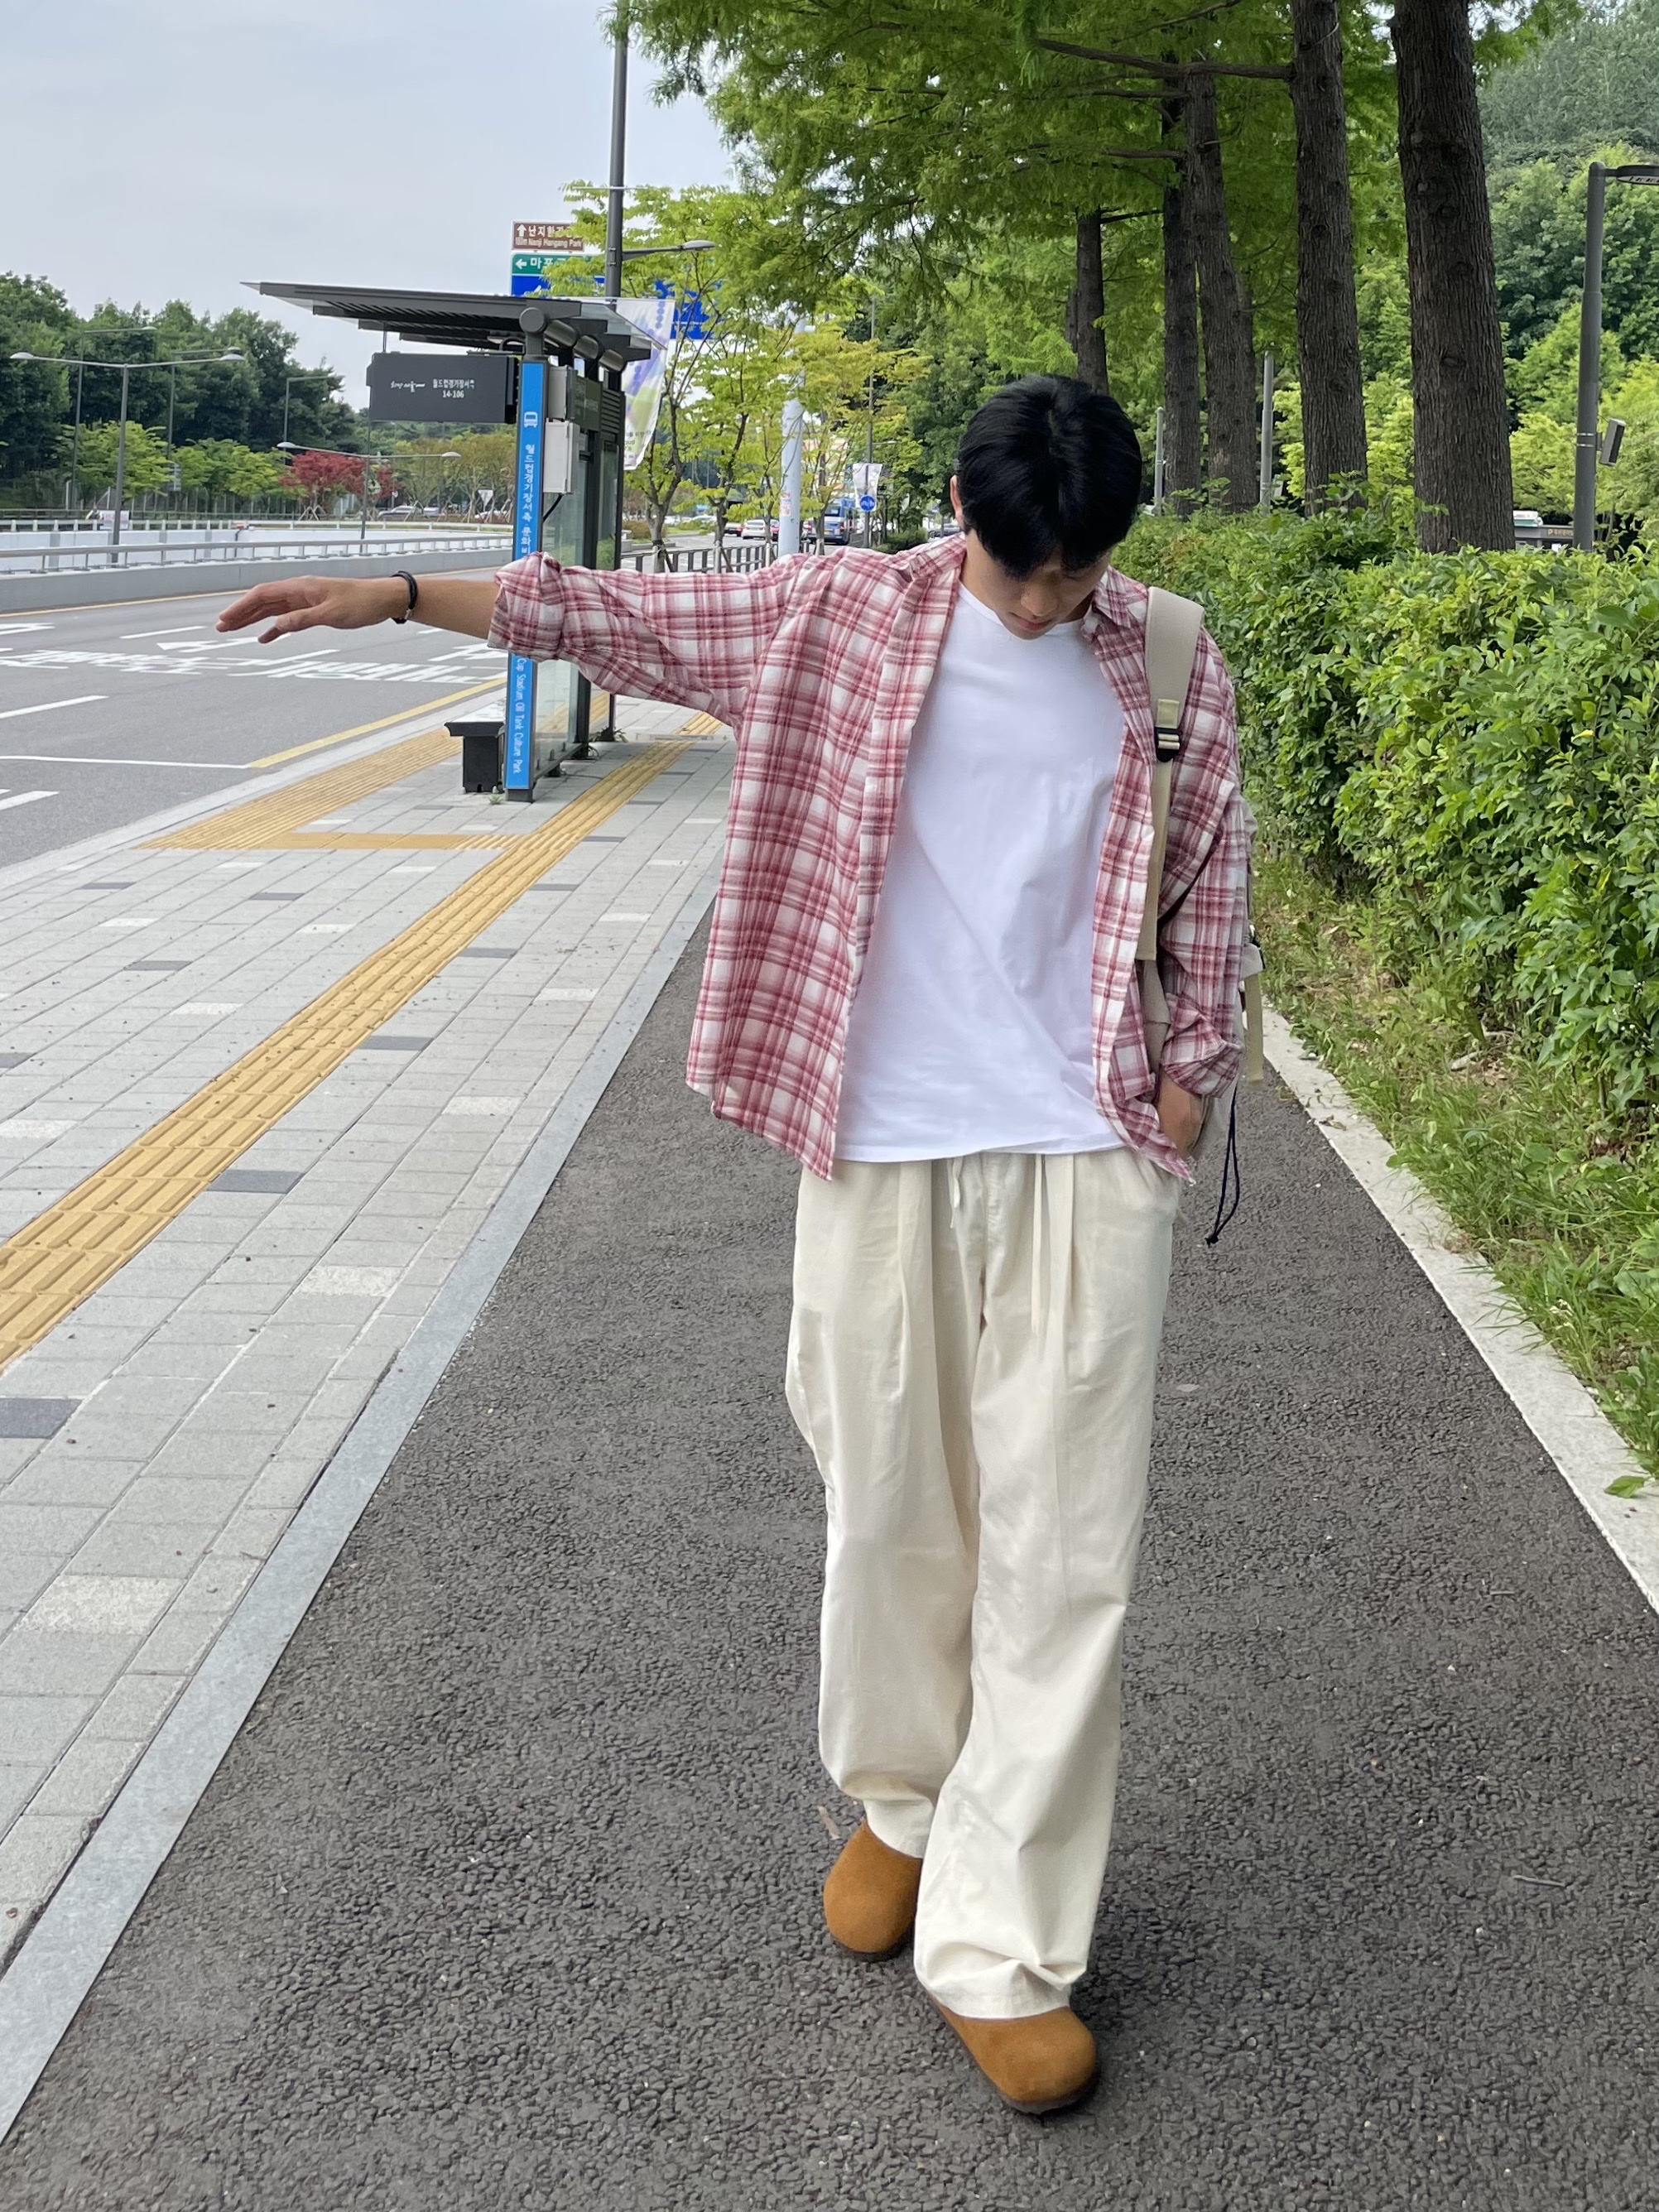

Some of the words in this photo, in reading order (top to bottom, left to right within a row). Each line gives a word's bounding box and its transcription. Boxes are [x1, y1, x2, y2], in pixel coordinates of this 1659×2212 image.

[569, 239, 582, 248] Park
[517, 657, 527, 672] Cup
[515, 702, 525, 713] Oil
[514, 714, 525, 730] Tank
[513, 732, 524, 757] Culture
[512, 759, 523, 774] Park
